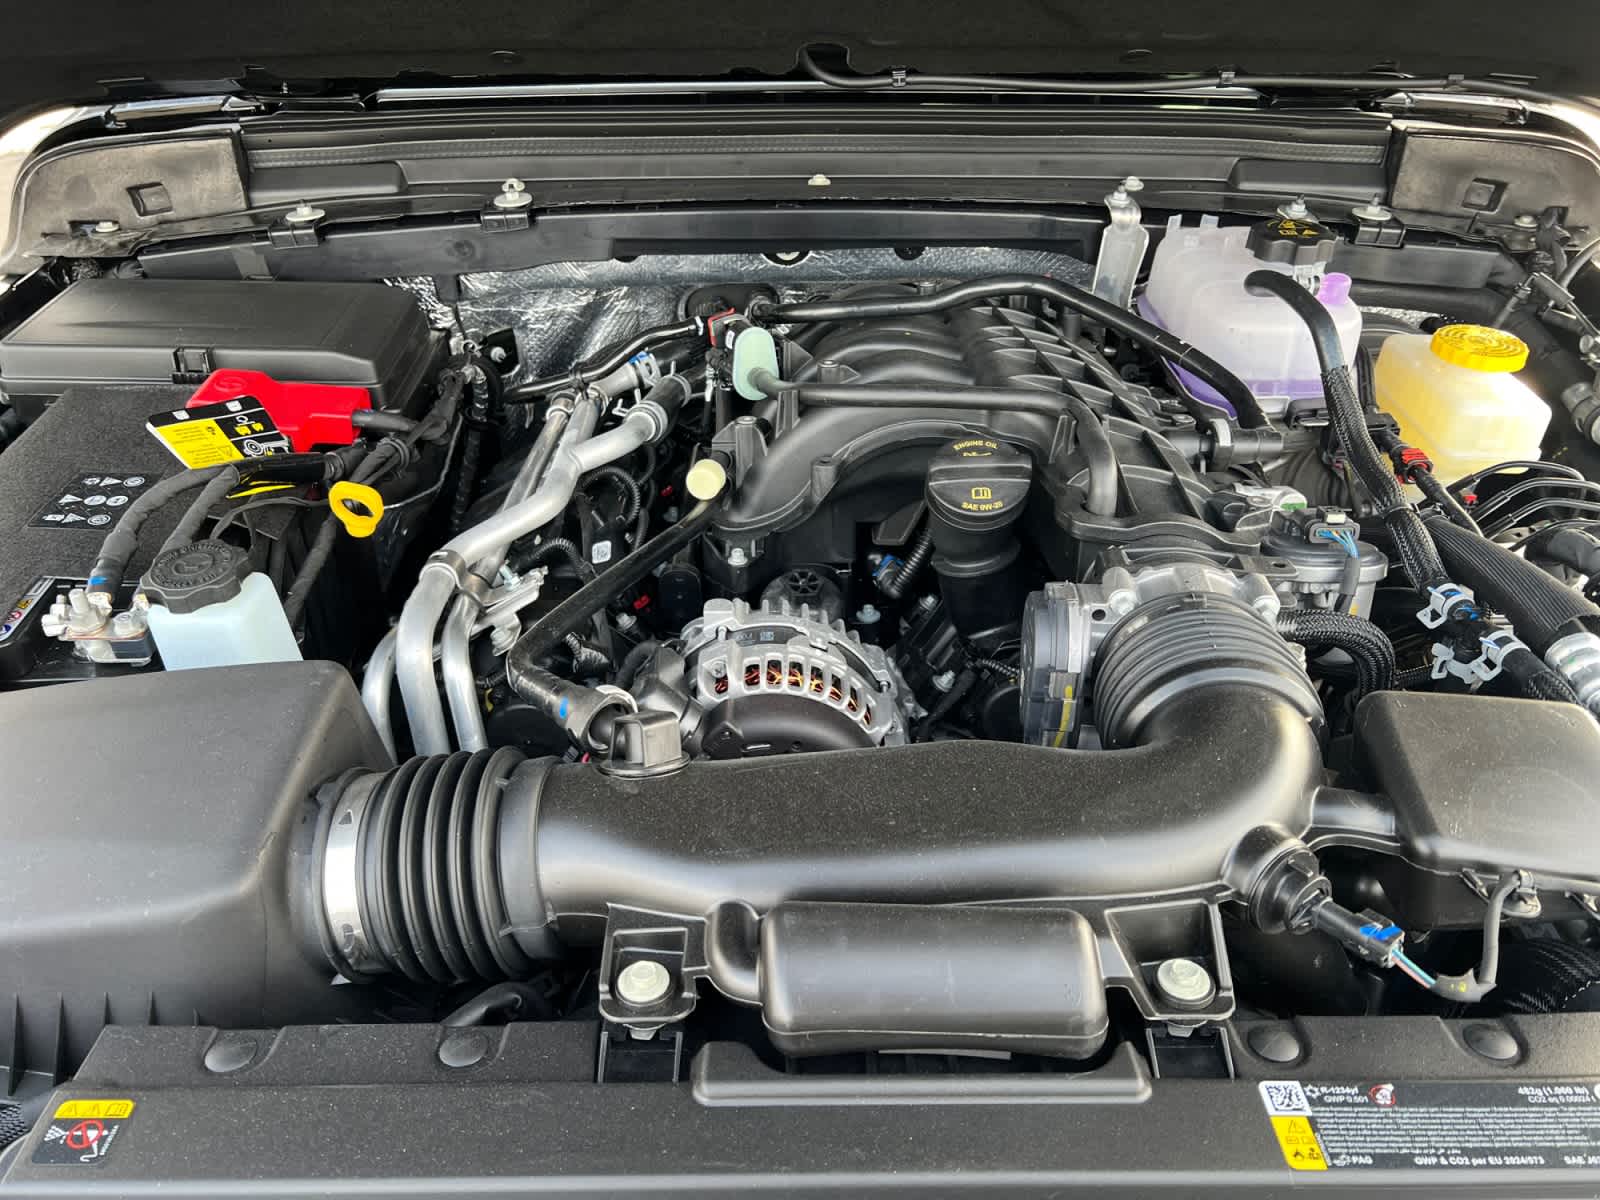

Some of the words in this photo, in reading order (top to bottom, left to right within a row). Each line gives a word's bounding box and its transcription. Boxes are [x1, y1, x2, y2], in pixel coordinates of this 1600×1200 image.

[953, 440, 984, 450] ENGINE
[985, 441, 998, 449] OIL
[961, 501, 979, 511] SAE
[1351, 1155, 1373, 1165] PAG
[1415, 1156, 1437, 1165] GWP
[1449, 1156, 1470, 1165] CO2
